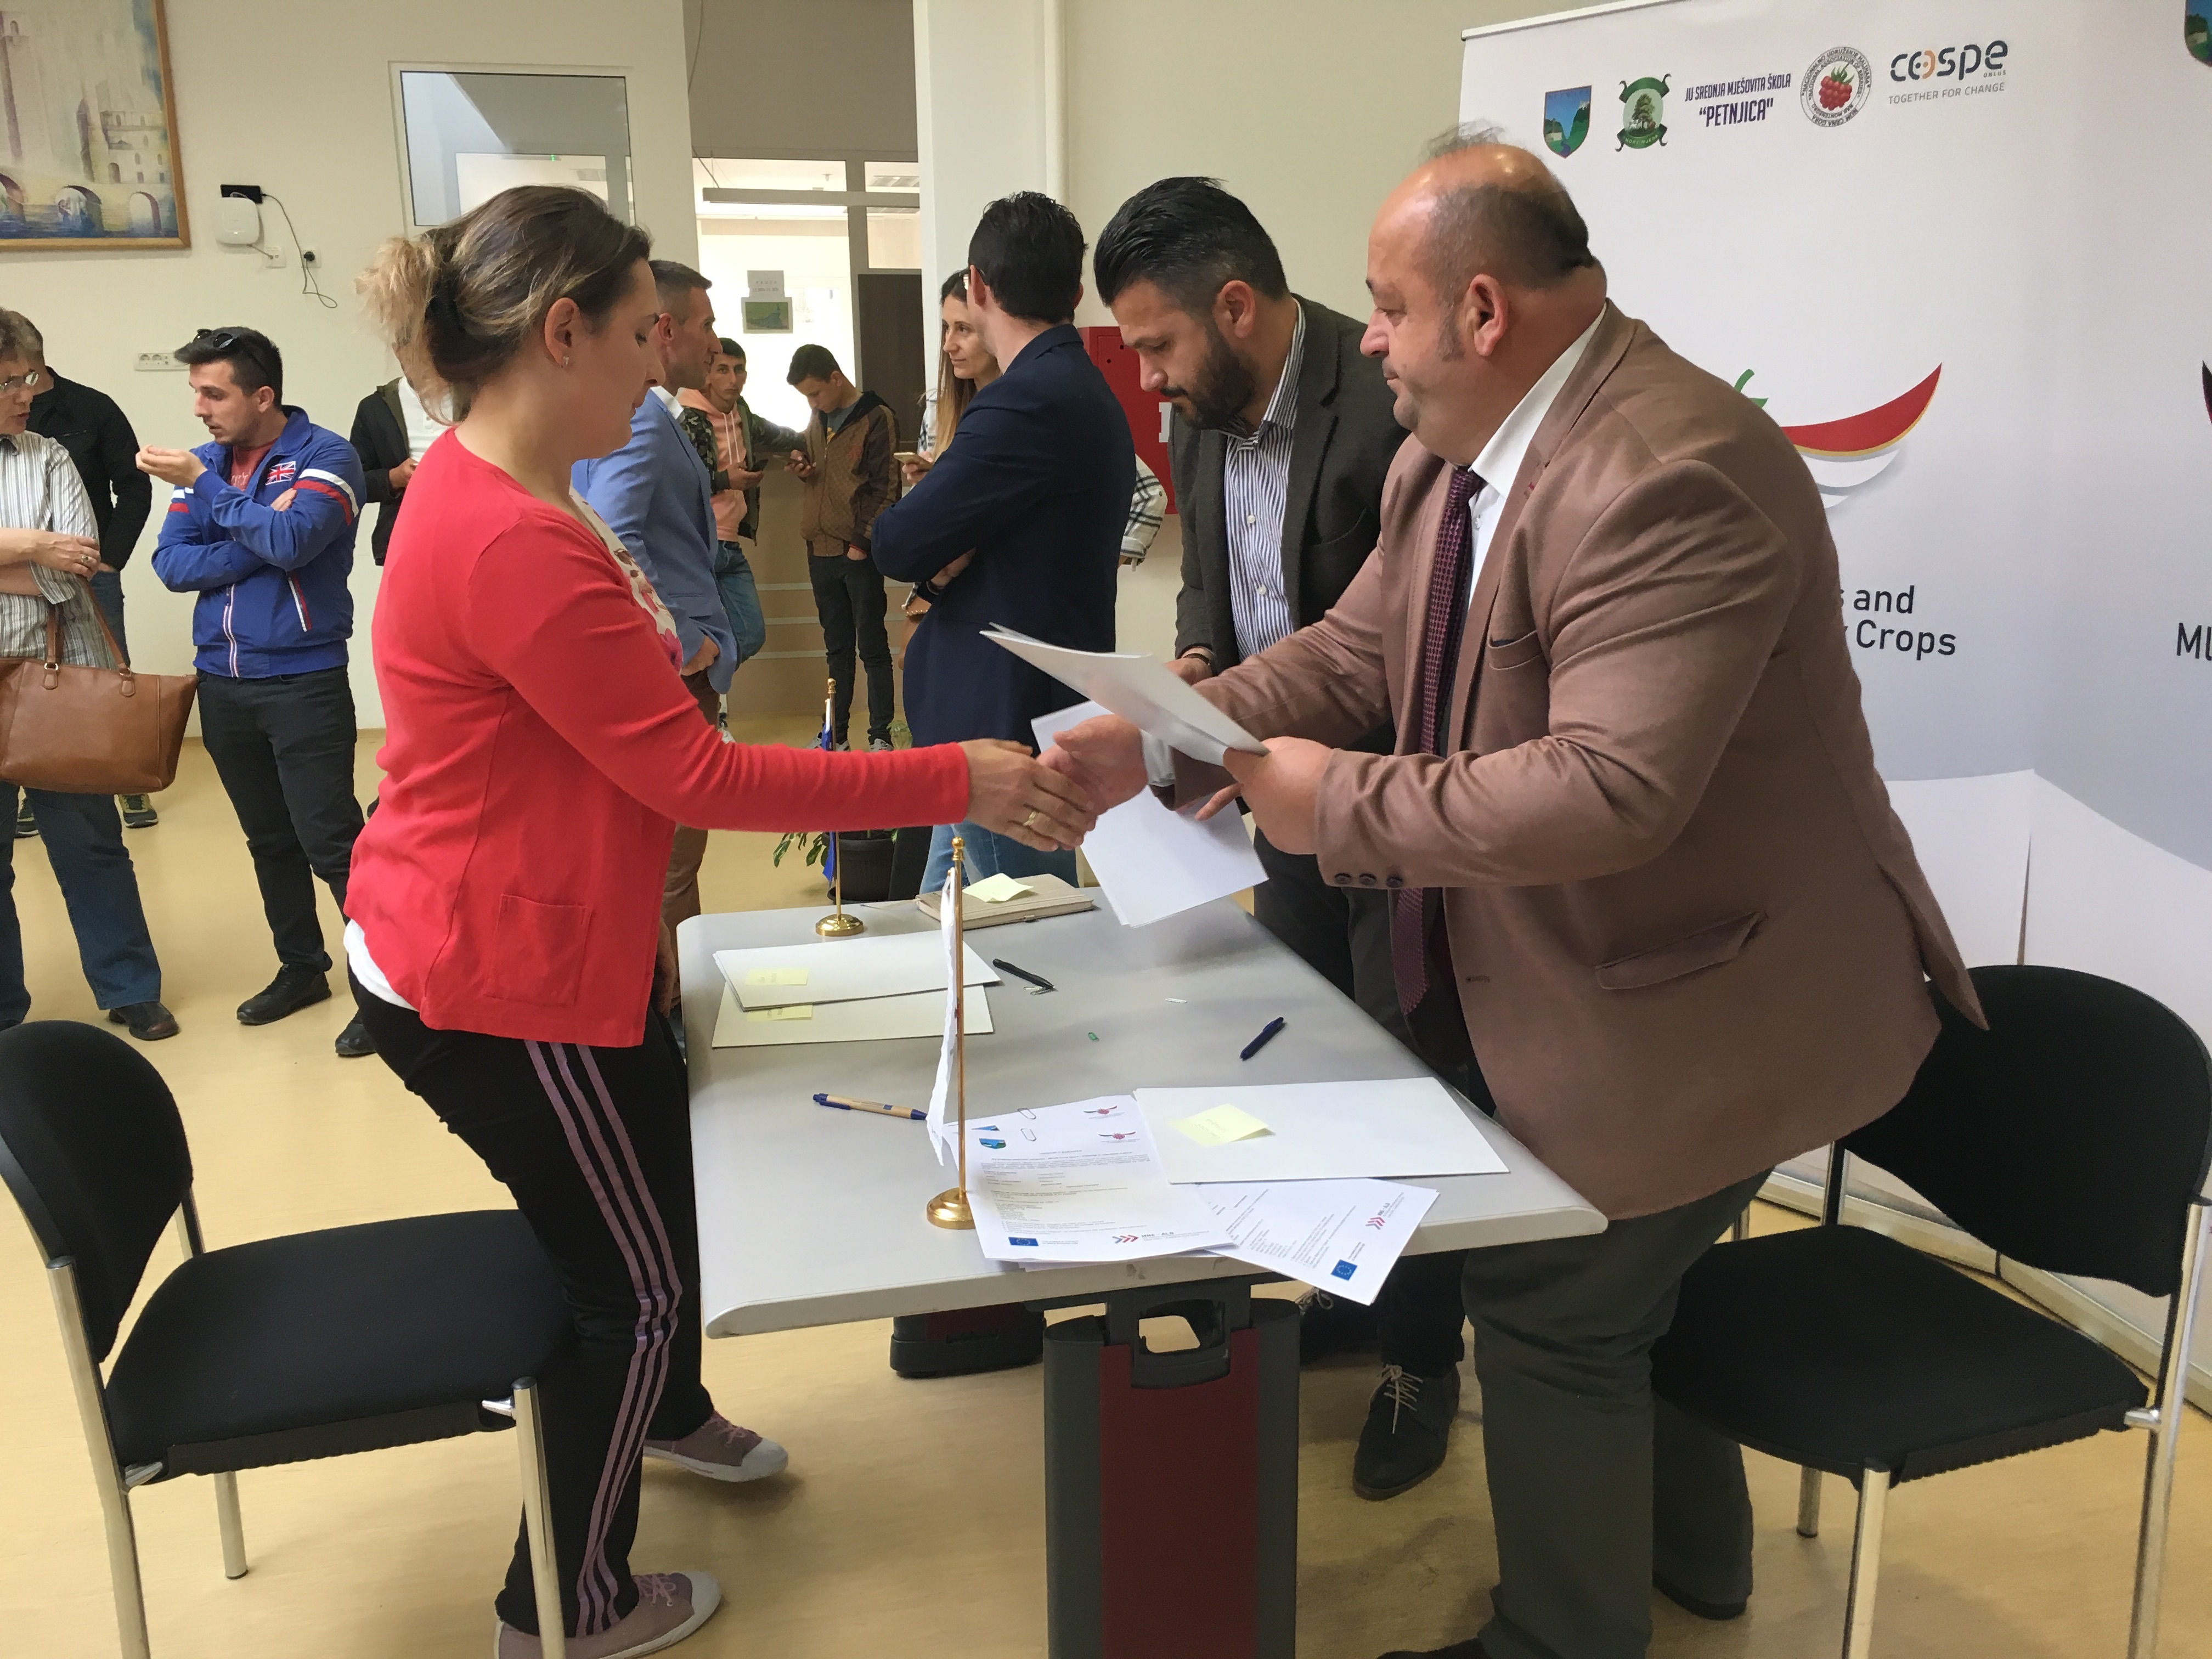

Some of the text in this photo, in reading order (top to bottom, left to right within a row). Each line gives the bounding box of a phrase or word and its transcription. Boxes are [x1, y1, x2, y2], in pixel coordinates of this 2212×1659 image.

[1685, 73, 1791, 102] JU SREDNJA MJEŠOVITA ŠKOLA
[1888, 82, 2006, 105] TOGETHER FOR CHANGE
[1853, 585, 1915, 614] and
[1856, 619, 1957, 661] Crops
